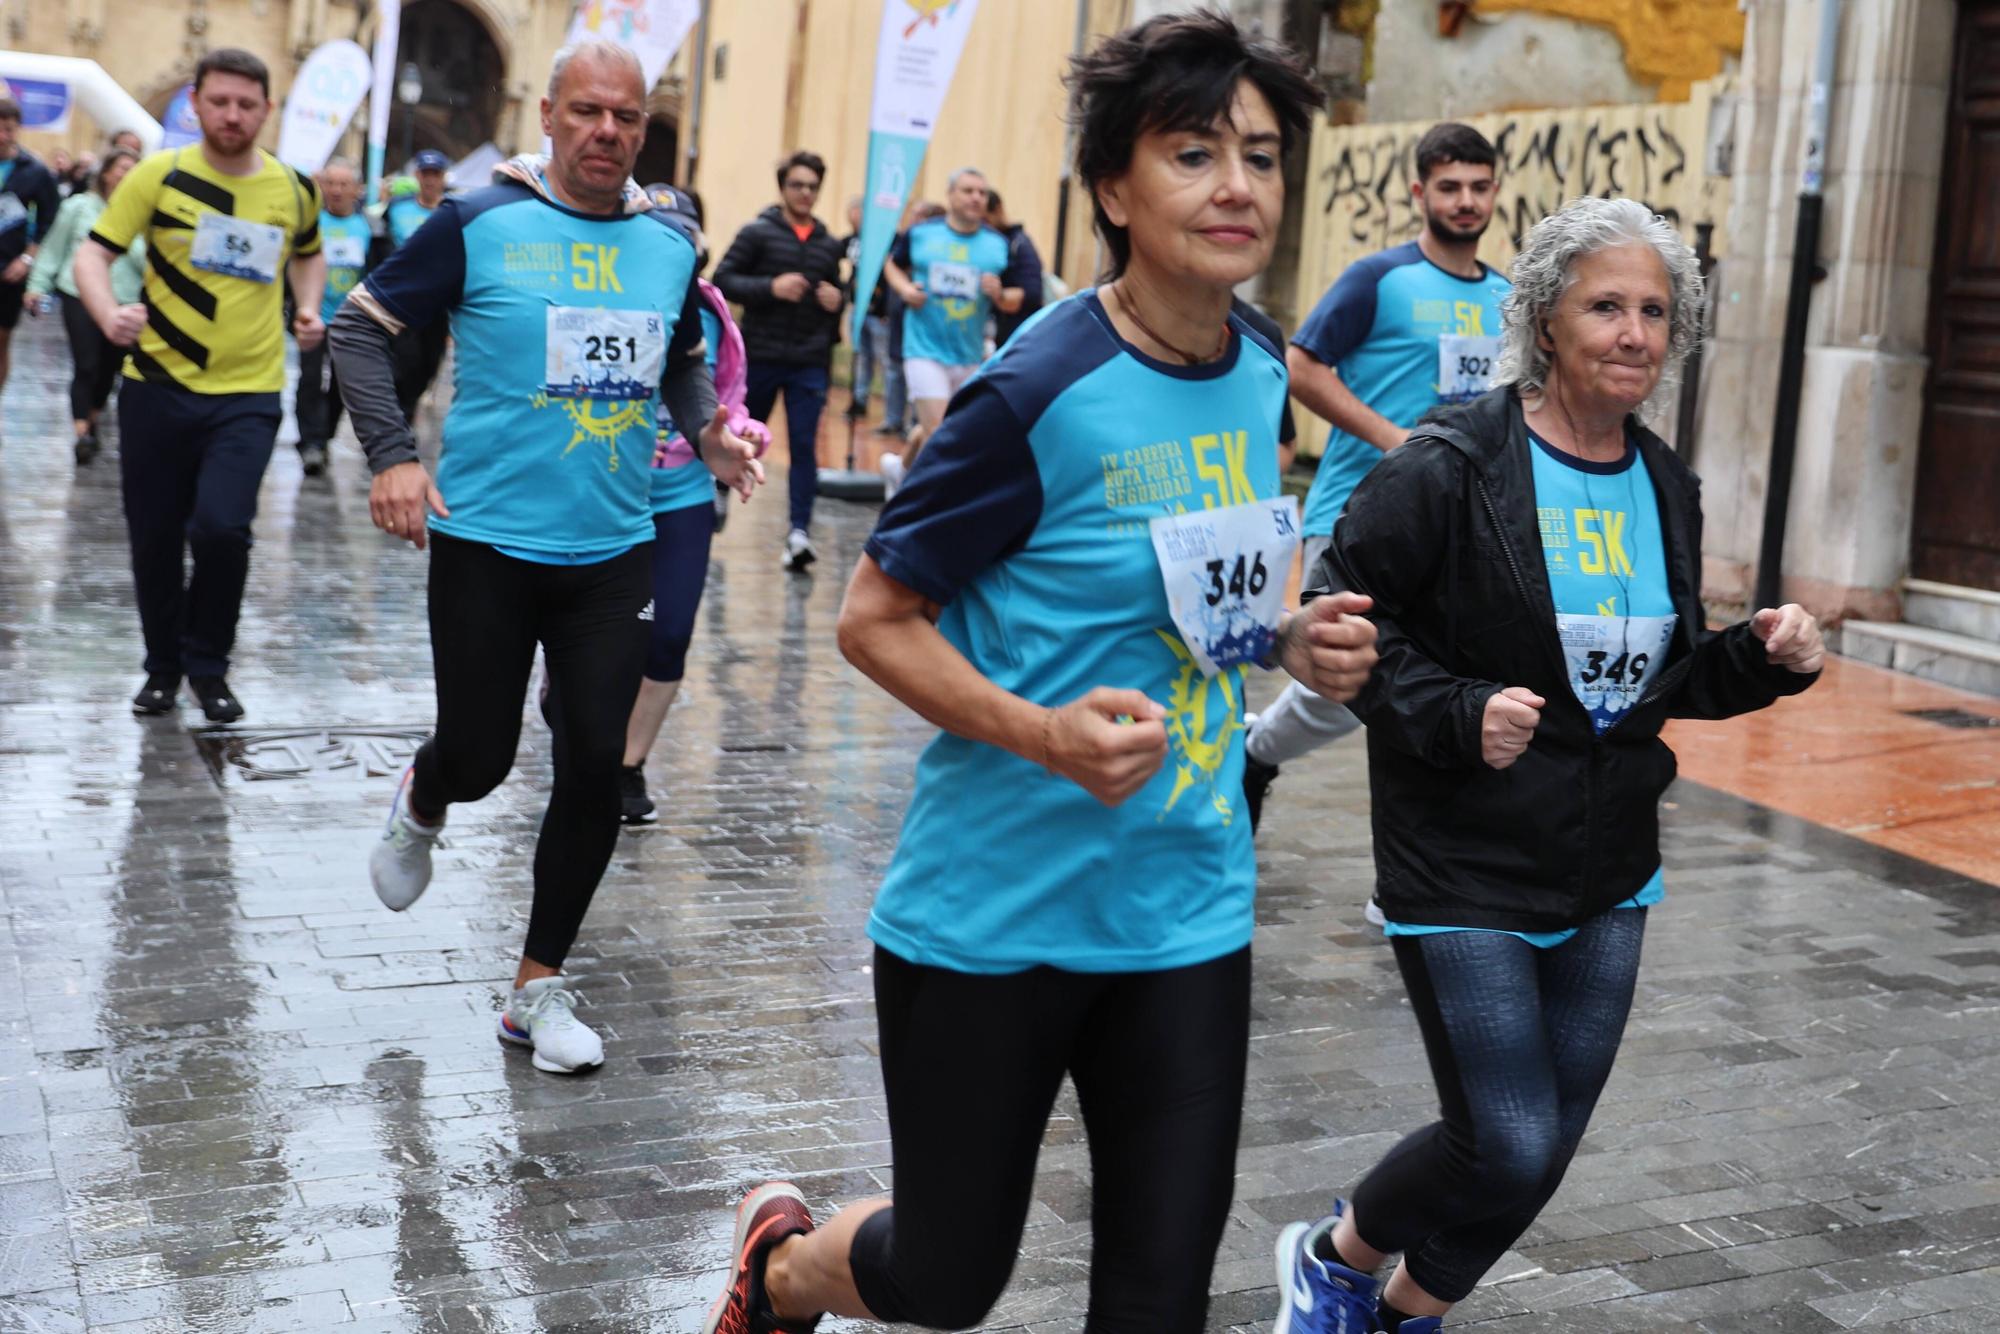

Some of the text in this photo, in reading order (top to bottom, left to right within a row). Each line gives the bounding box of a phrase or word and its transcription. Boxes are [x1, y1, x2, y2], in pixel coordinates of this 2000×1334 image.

[572, 243, 624, 293] 5K
[1455, 300, 1485, 336] 5K
[586, 335, 635, 363] 251
[1458, 356, 1490, 376] 302
[1190, 430, 1258, 511] 5K
[1272, 507, 1296, 536] 5K
[1574, 508, 1635, 577] 5K
[1204, 551, 1268, 607] 346
[1581, 651, 1649, 684] 349
